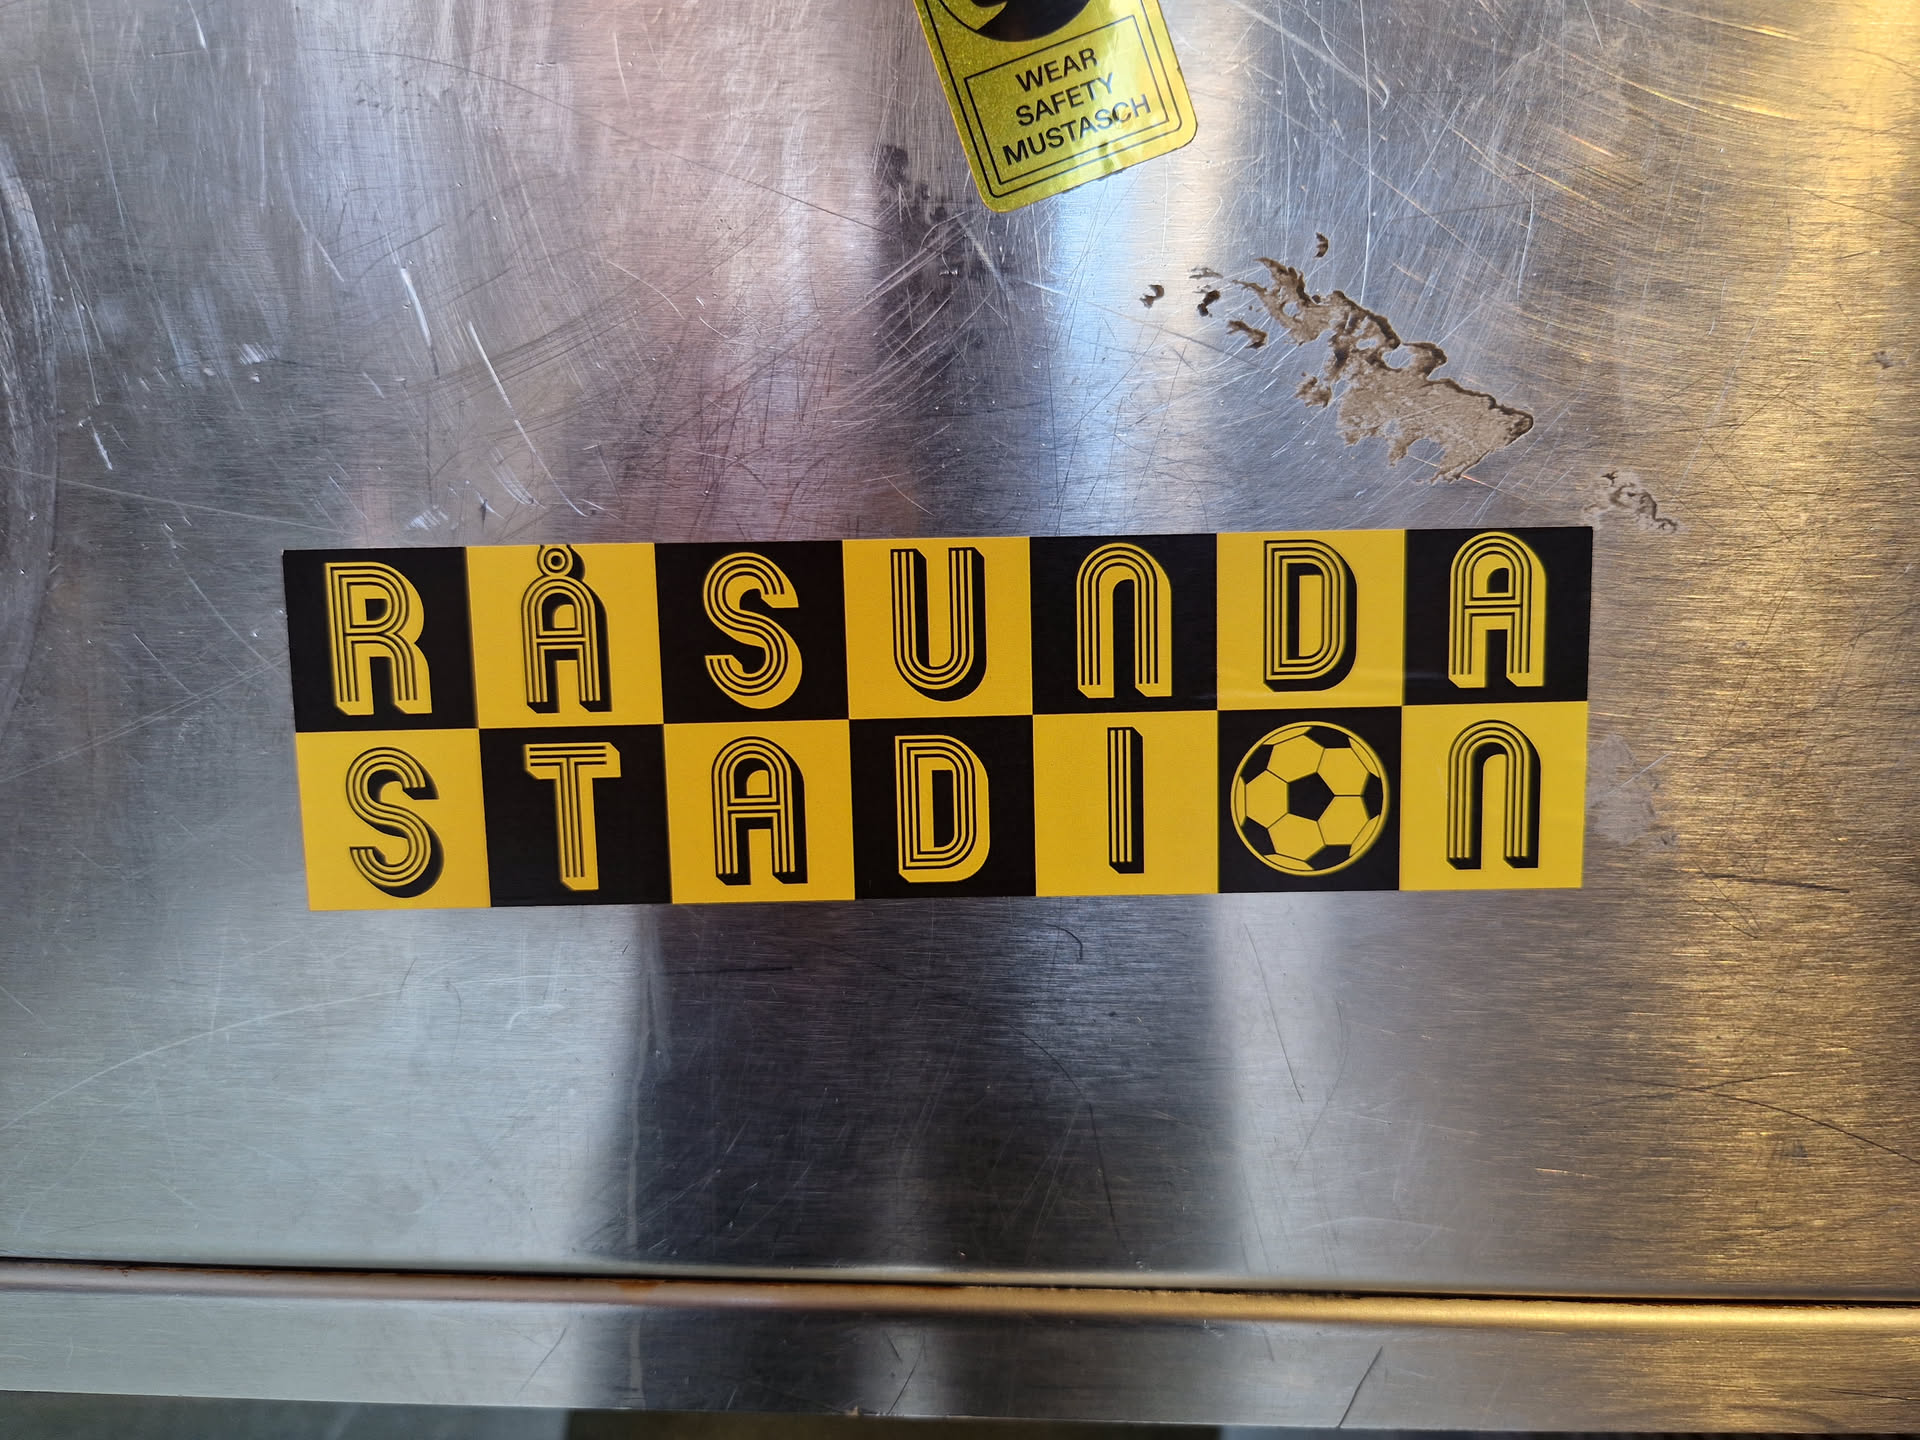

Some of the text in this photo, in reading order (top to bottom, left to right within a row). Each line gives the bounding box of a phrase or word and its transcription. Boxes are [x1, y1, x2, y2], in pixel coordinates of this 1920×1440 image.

[1015, 48, 1099, 92] WEAR
[1015, 72, 1114, 126] SAFETY
[1002, 94, 1151, 166] MUSTASCH
[324, 532, 1547, 717] RÅSUNDA
